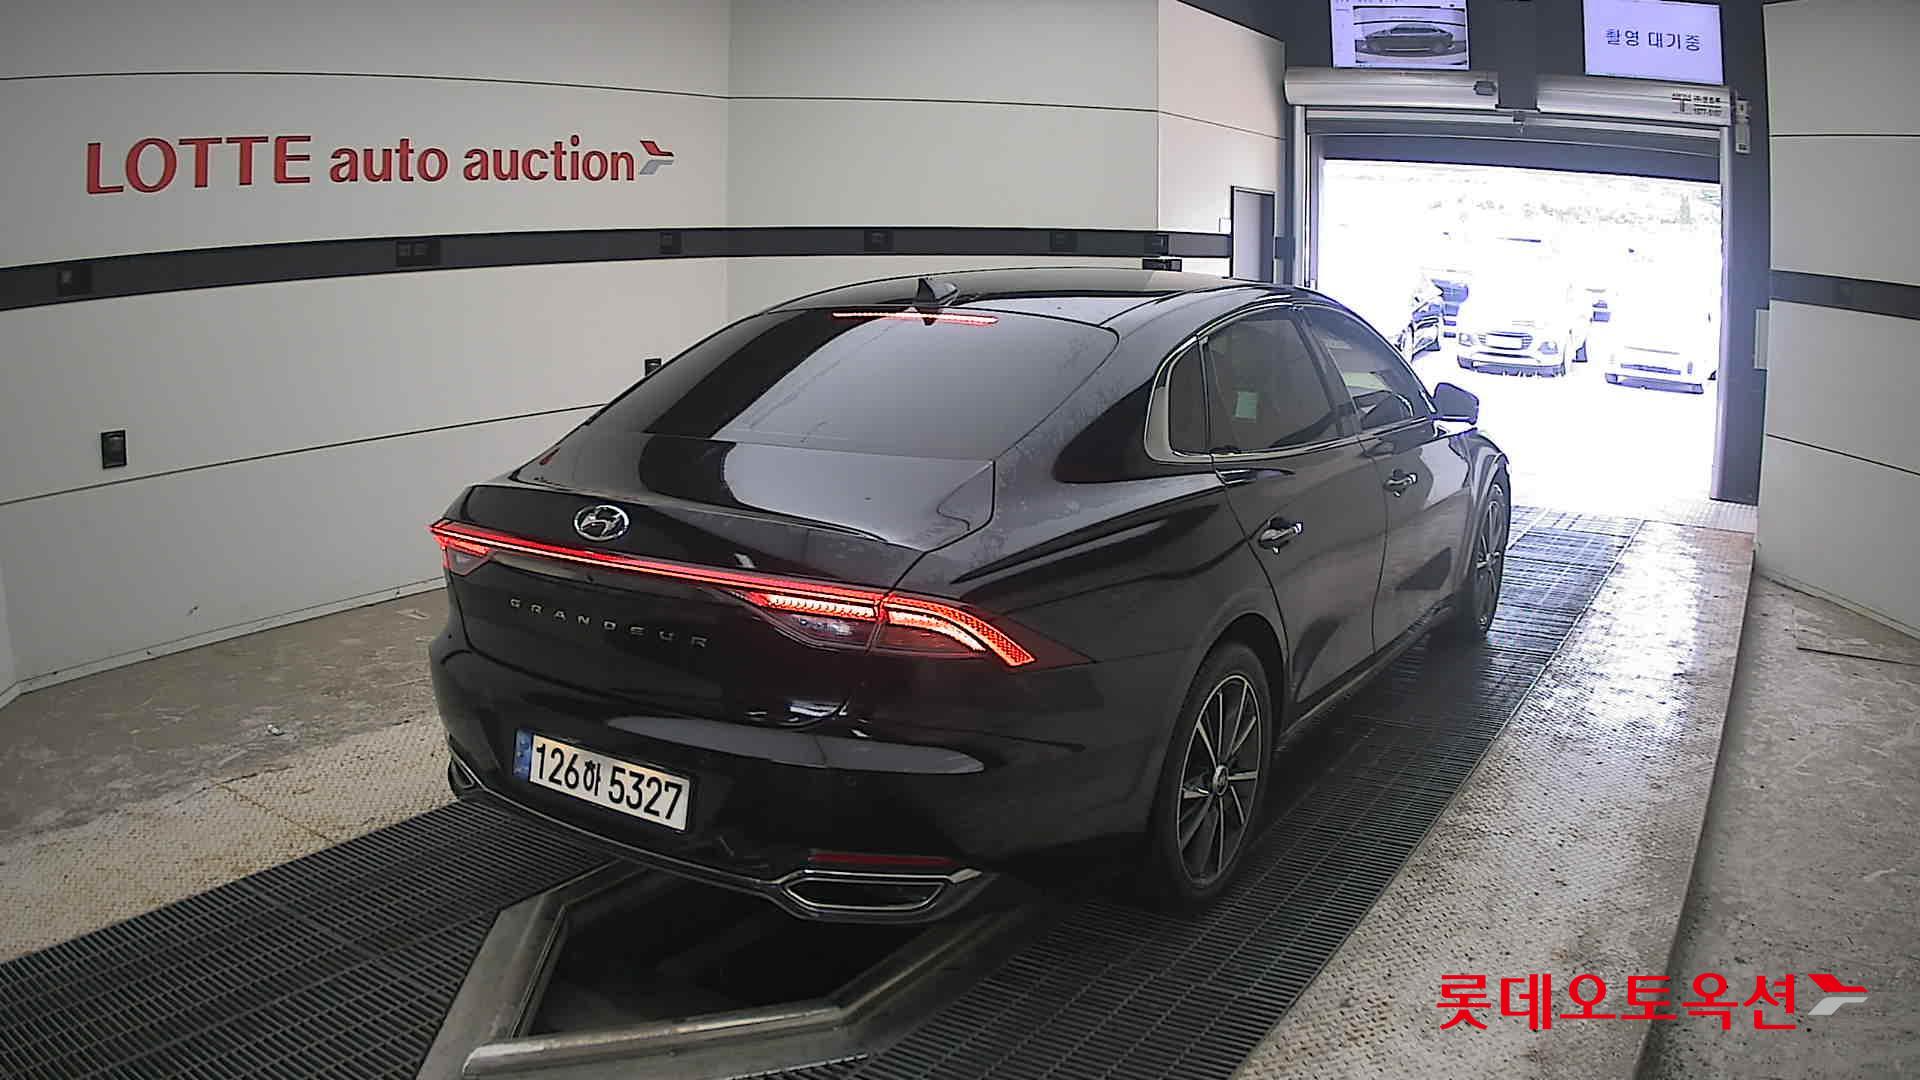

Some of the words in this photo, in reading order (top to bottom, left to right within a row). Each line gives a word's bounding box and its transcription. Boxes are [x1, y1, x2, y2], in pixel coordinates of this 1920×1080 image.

[86, 135, 312, 194] LOTTE
[329, 138, 449, 183] auto
[463, 135, 635, 182] auction
[509, 597, 708, 649] GRANDEUR
[536, 743, 601, 797] 126하
[608, 765, 683, 820] 5327
